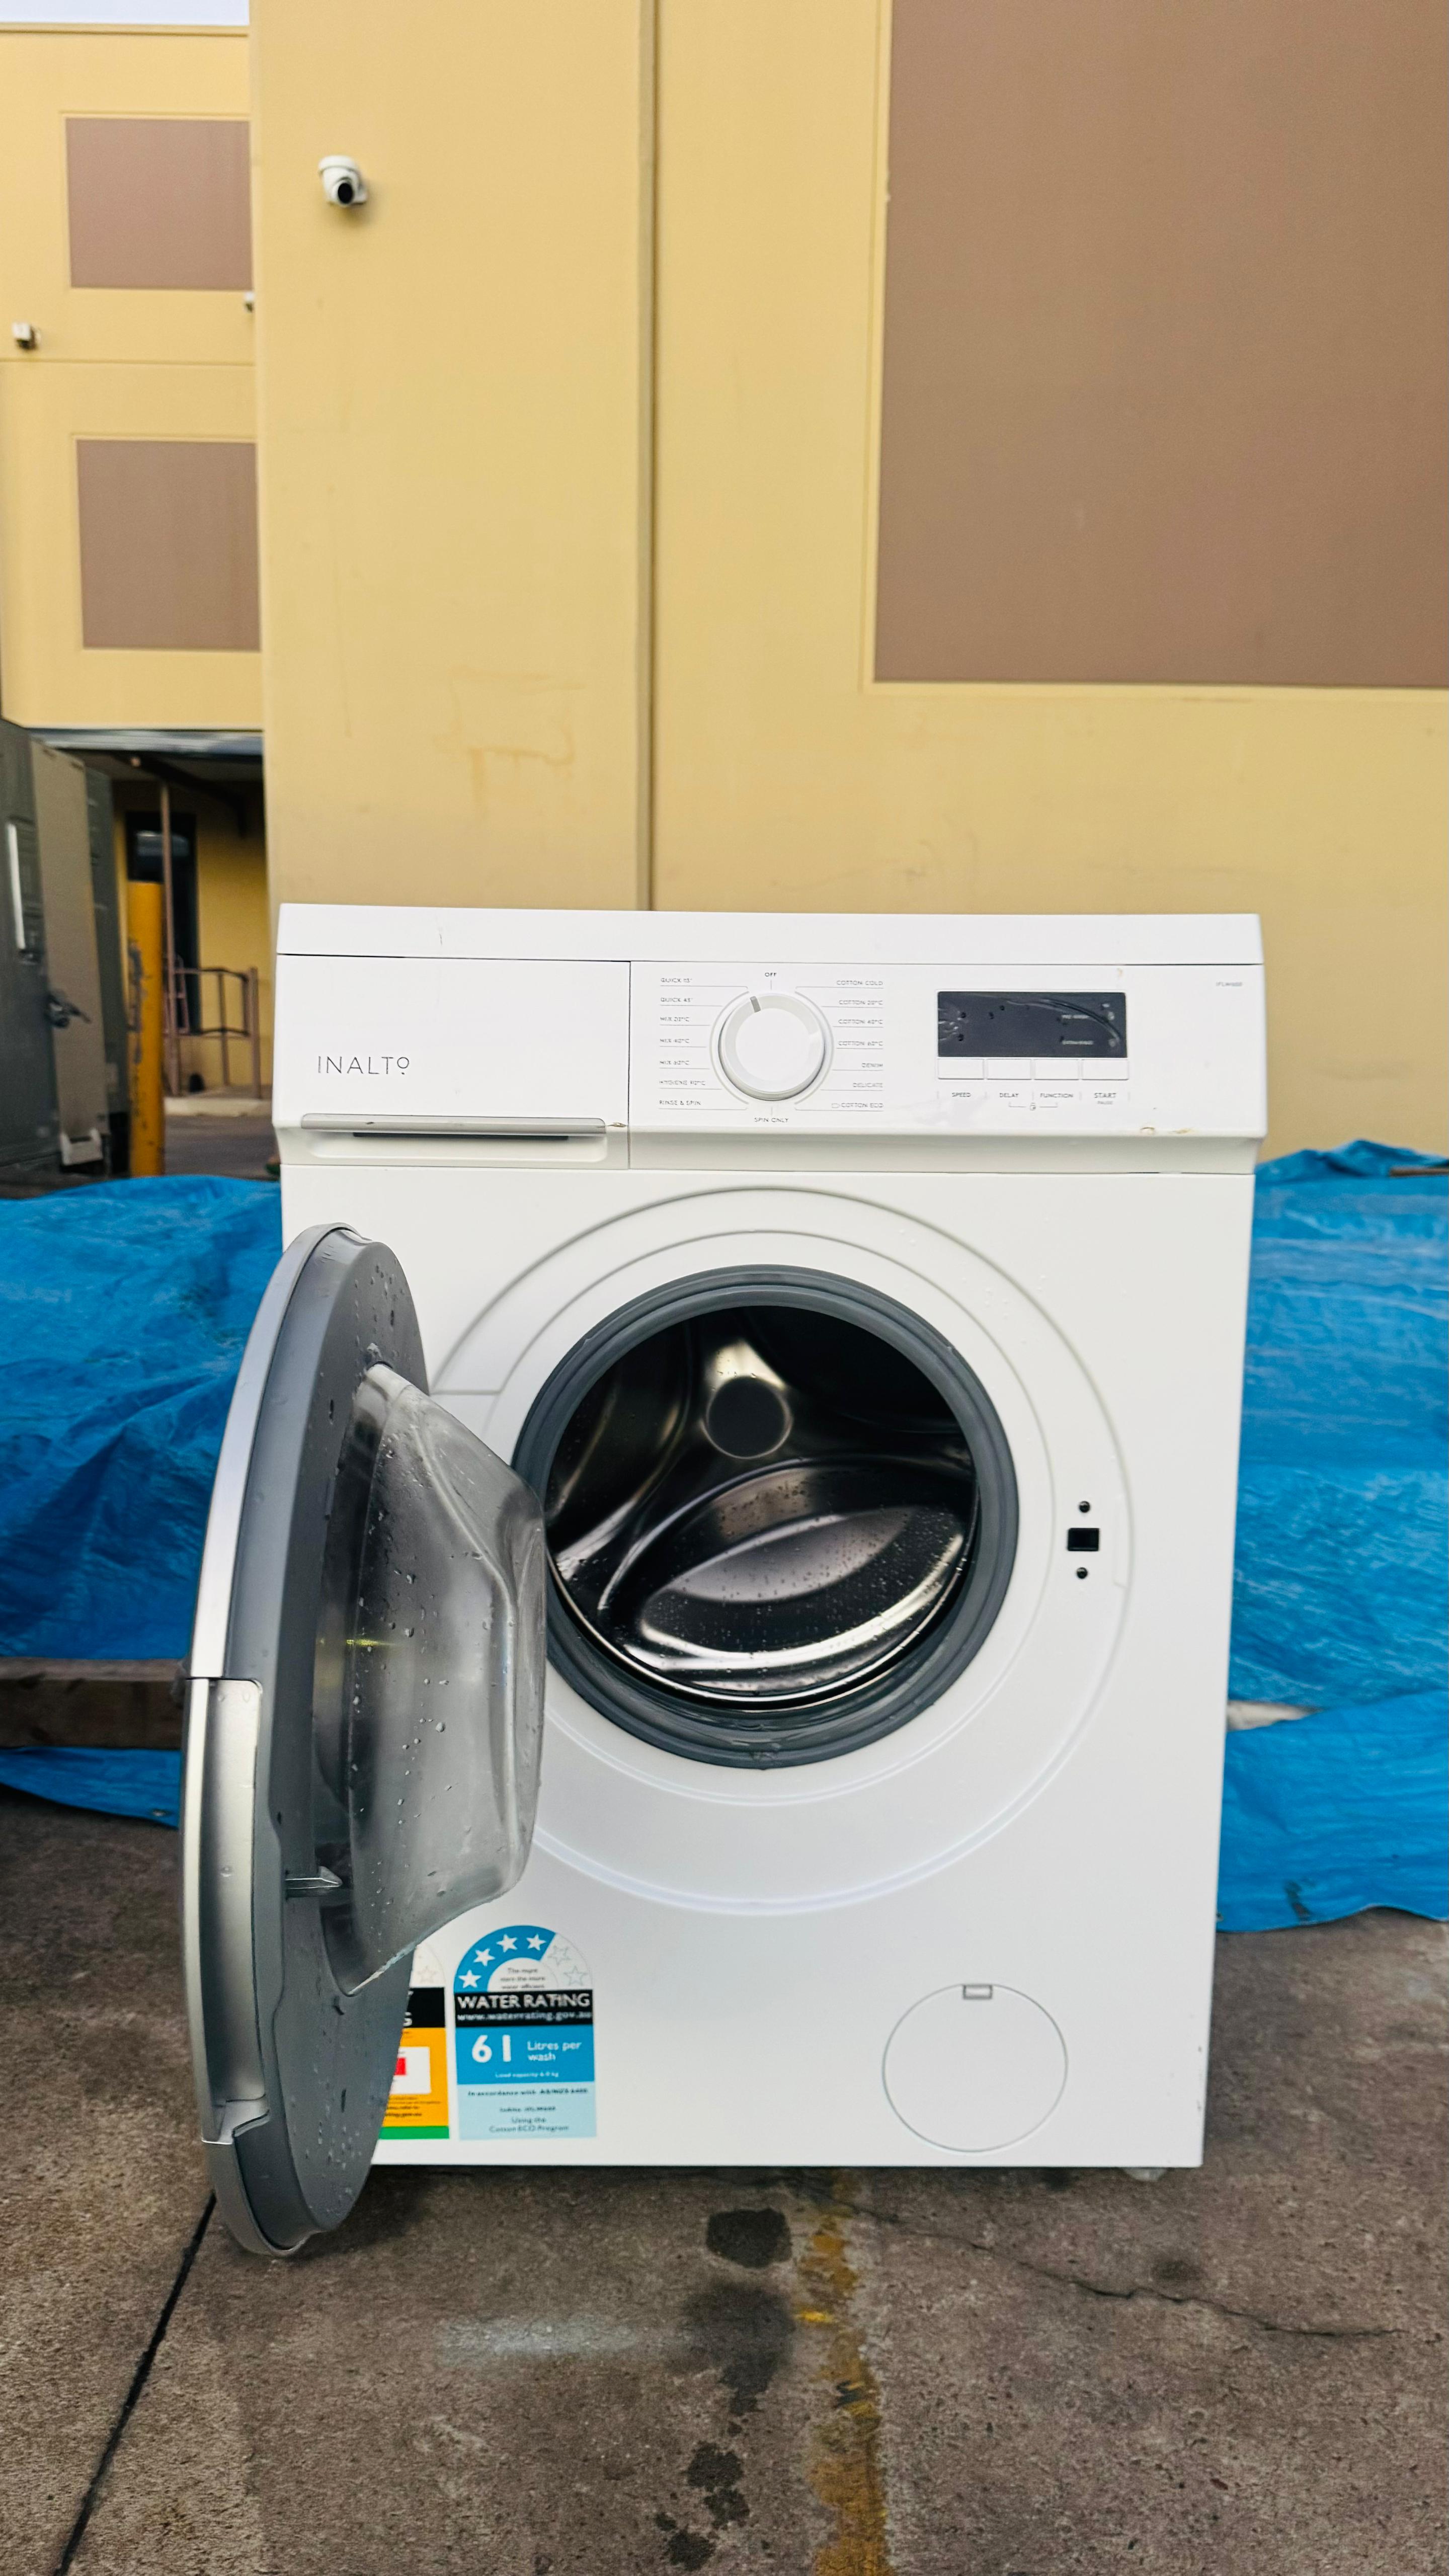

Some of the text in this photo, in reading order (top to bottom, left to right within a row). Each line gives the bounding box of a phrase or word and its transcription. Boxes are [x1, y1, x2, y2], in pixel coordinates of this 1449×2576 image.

[318, 1056, 410, 1075] INALTO
[457, 1993, 591, 2009] WATER RATING
[457, 2010, 591, 2022] www.waterrating.gov.au
[527, 2040, 582, 2051] Litres per
[528, 2052, 556, 2062] wash
[512, 2117, 531, 2125] Using
[518, 2124, 536, 2132] ECO
[537, 2123, 569, 2133] Program
